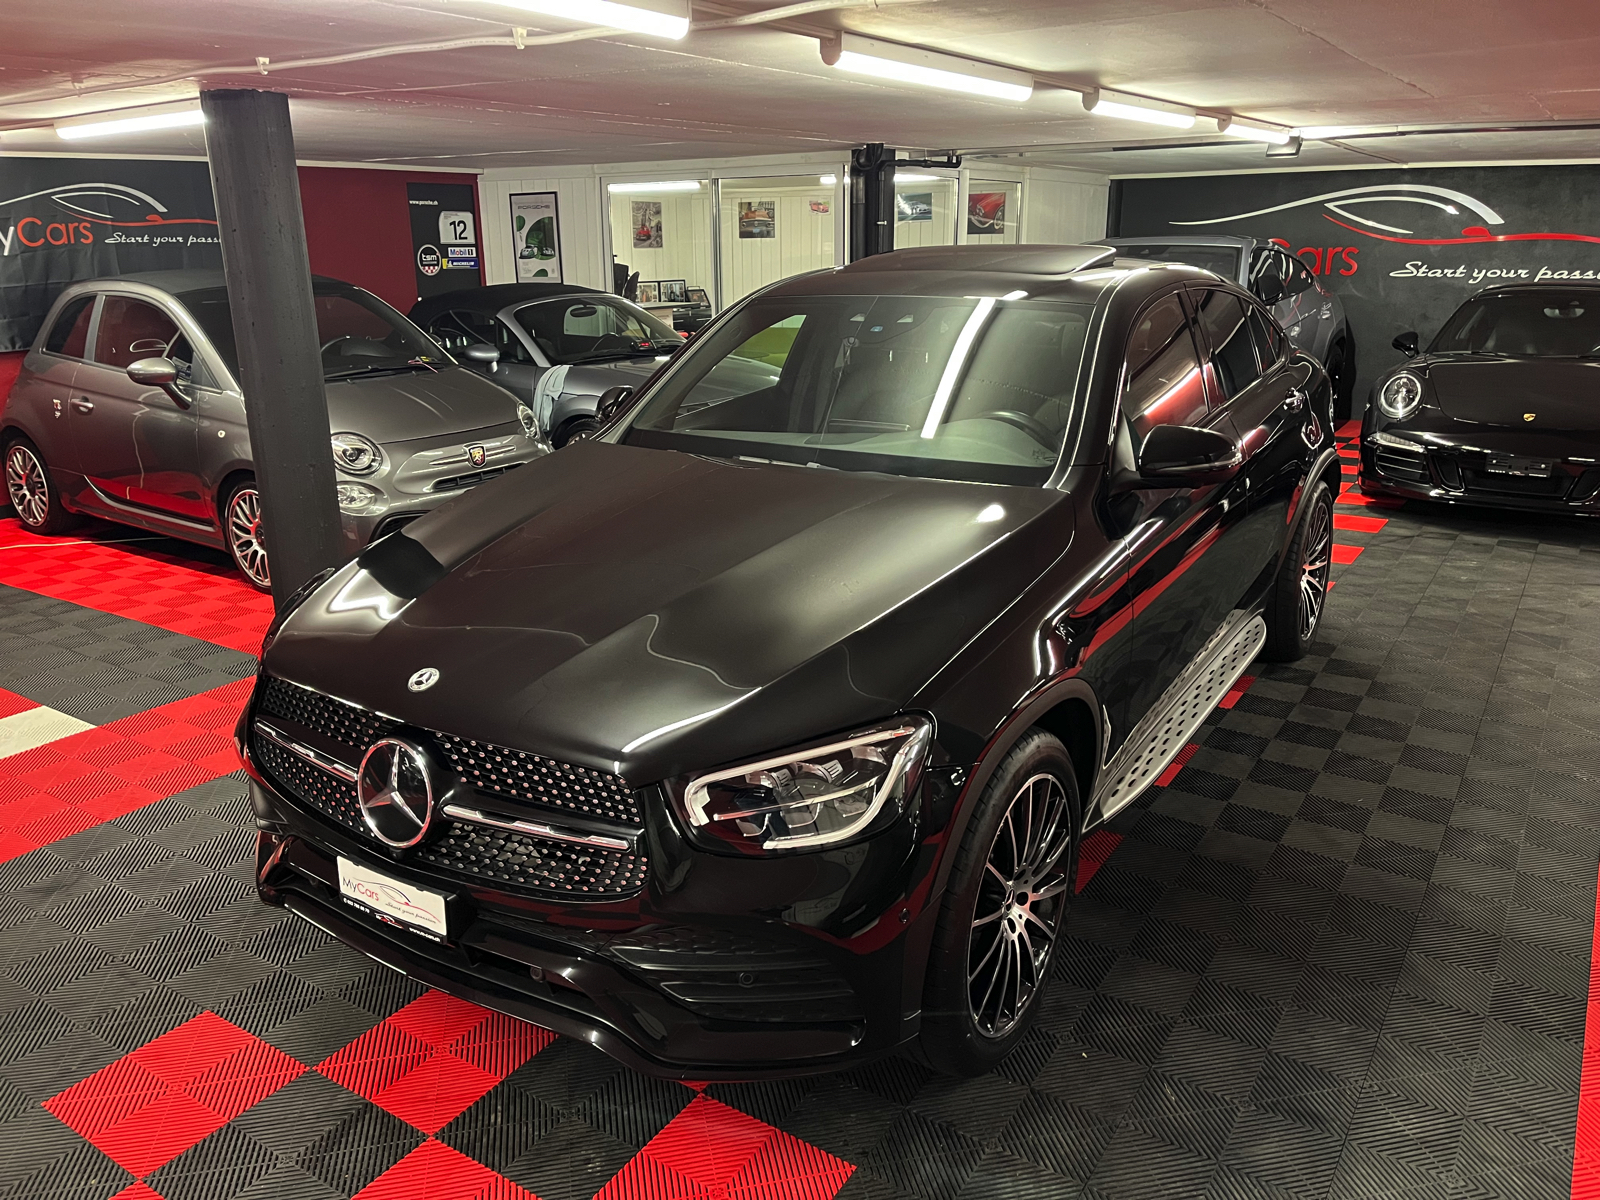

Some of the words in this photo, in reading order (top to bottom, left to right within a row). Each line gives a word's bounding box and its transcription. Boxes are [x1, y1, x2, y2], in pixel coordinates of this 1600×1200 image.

[104, 232, 150, 244] Start
[152, 235, 184, 247] your
[187, 235, 222, 247] pass
[449, 219, 468, 241] 12
[449, 248, 467, 256] Mobil
[1271, 238, 1360, 277] ars
[1389, 261, 1466, 278] Start
[1468, 264, 1530, 284] your
[342, 876, 380, 902] MyCars
[385, 901, 402, 912] Start
[402, 908, 415, 916] your
[414, 913, 437, 924] passion
